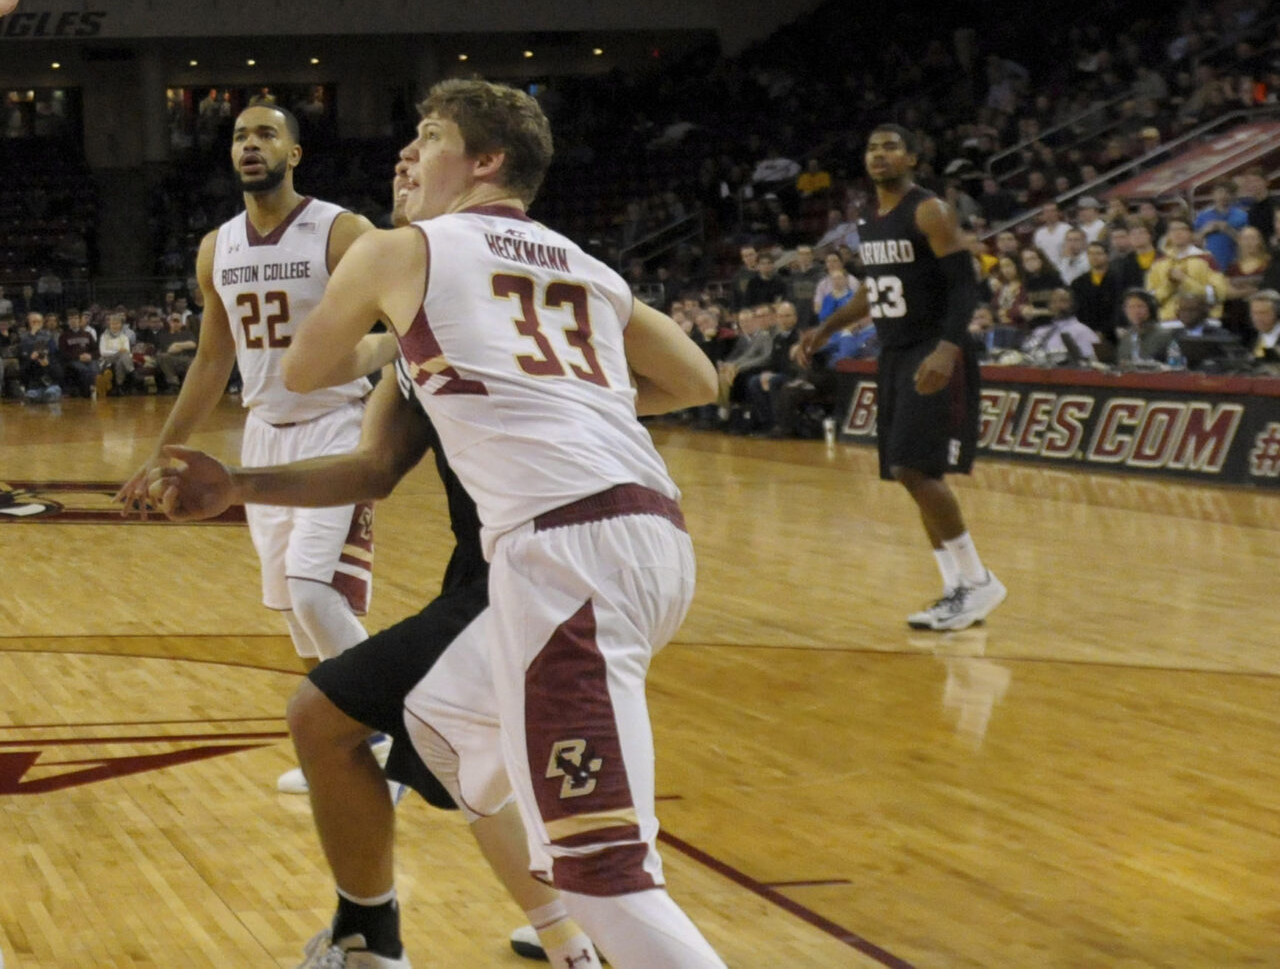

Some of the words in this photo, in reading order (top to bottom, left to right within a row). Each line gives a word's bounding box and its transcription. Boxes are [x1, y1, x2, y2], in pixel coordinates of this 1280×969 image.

[222, 264, 259, 286] BOSTON
[263, 261, 310, 281] COLLEGE
[484, 233, 571, 273] HECKMANN
[236, 290, 292, 349] 22
[489, 270, 612, 389] 33
